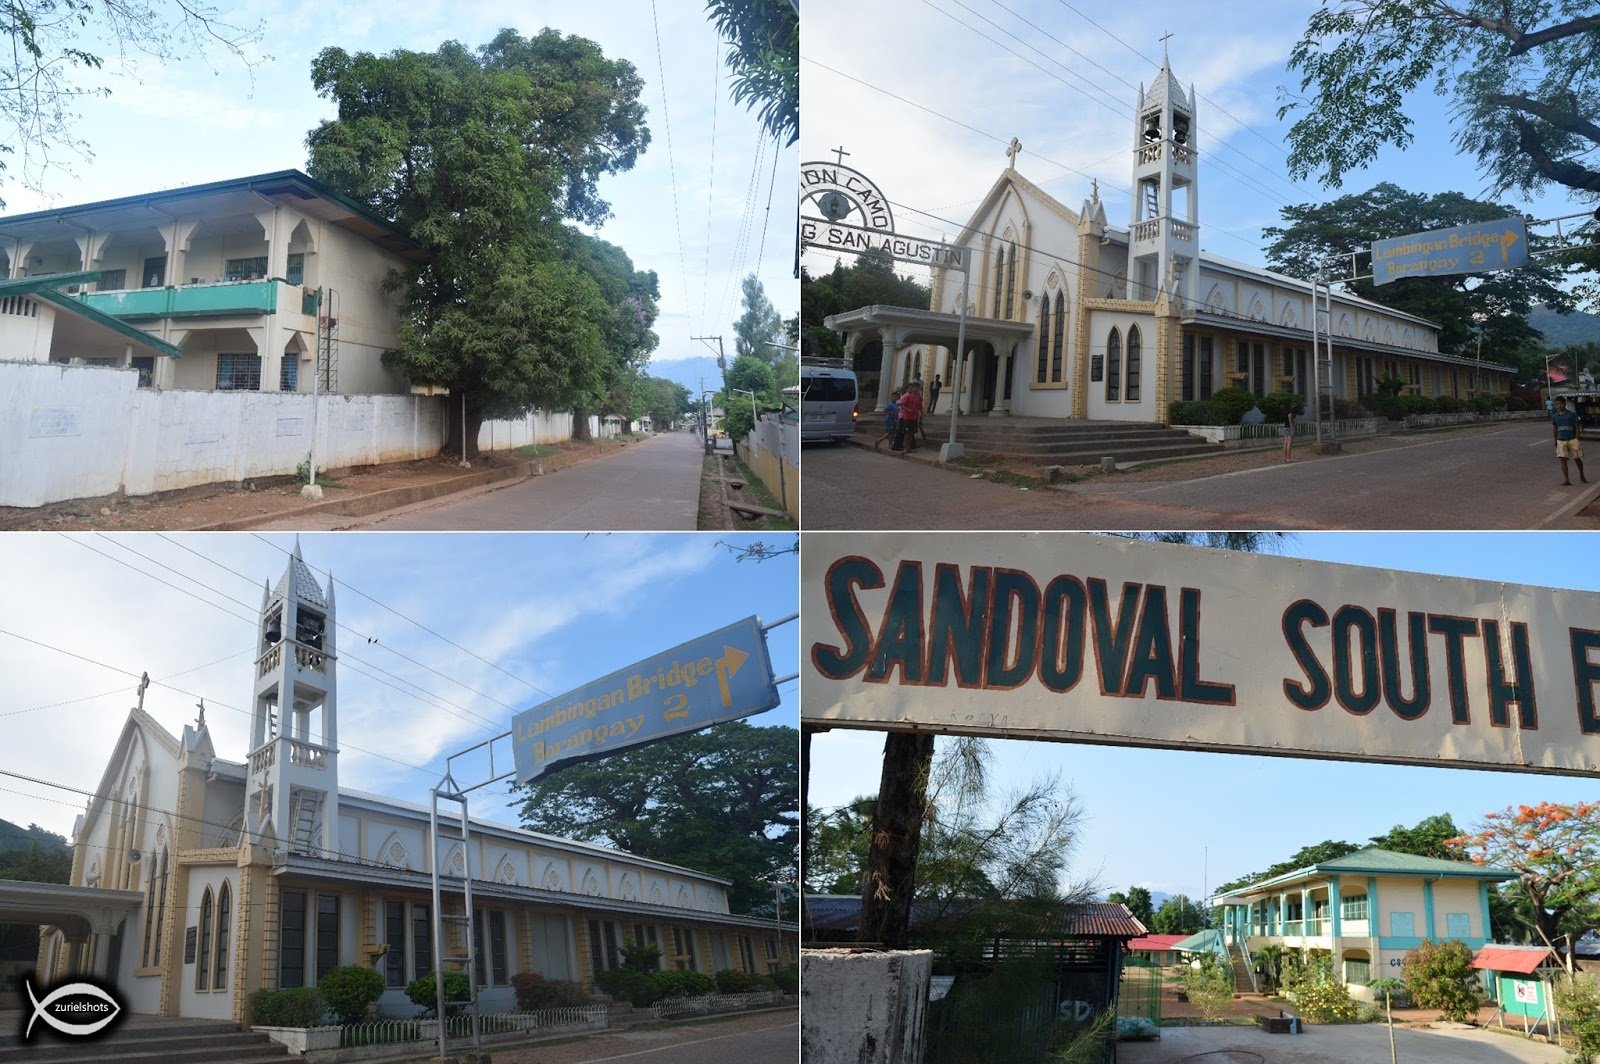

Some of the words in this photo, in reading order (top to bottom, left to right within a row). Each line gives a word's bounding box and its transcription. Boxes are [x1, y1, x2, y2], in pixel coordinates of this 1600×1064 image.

[846, 177, 888, 228] CAMO
[828, 228, 871, 250] SAN
[880, 238, 962, 266] AGUSTIN
[1387, 256, 1460, 276] Barangay
[1470, 251, 1485, 265] 2
[1449, 231, 1499, 249] Bridge
[810, 554, 1236, 706] SANDOVAL
[1282, 599, 1538, 730] SOUTH
[517, 688, 624, 743] Lambingan
[626, 656, 714, 700] Bridge
[532, 713, 645, 765] Barangay
[663, 693, 689, 722] 2
